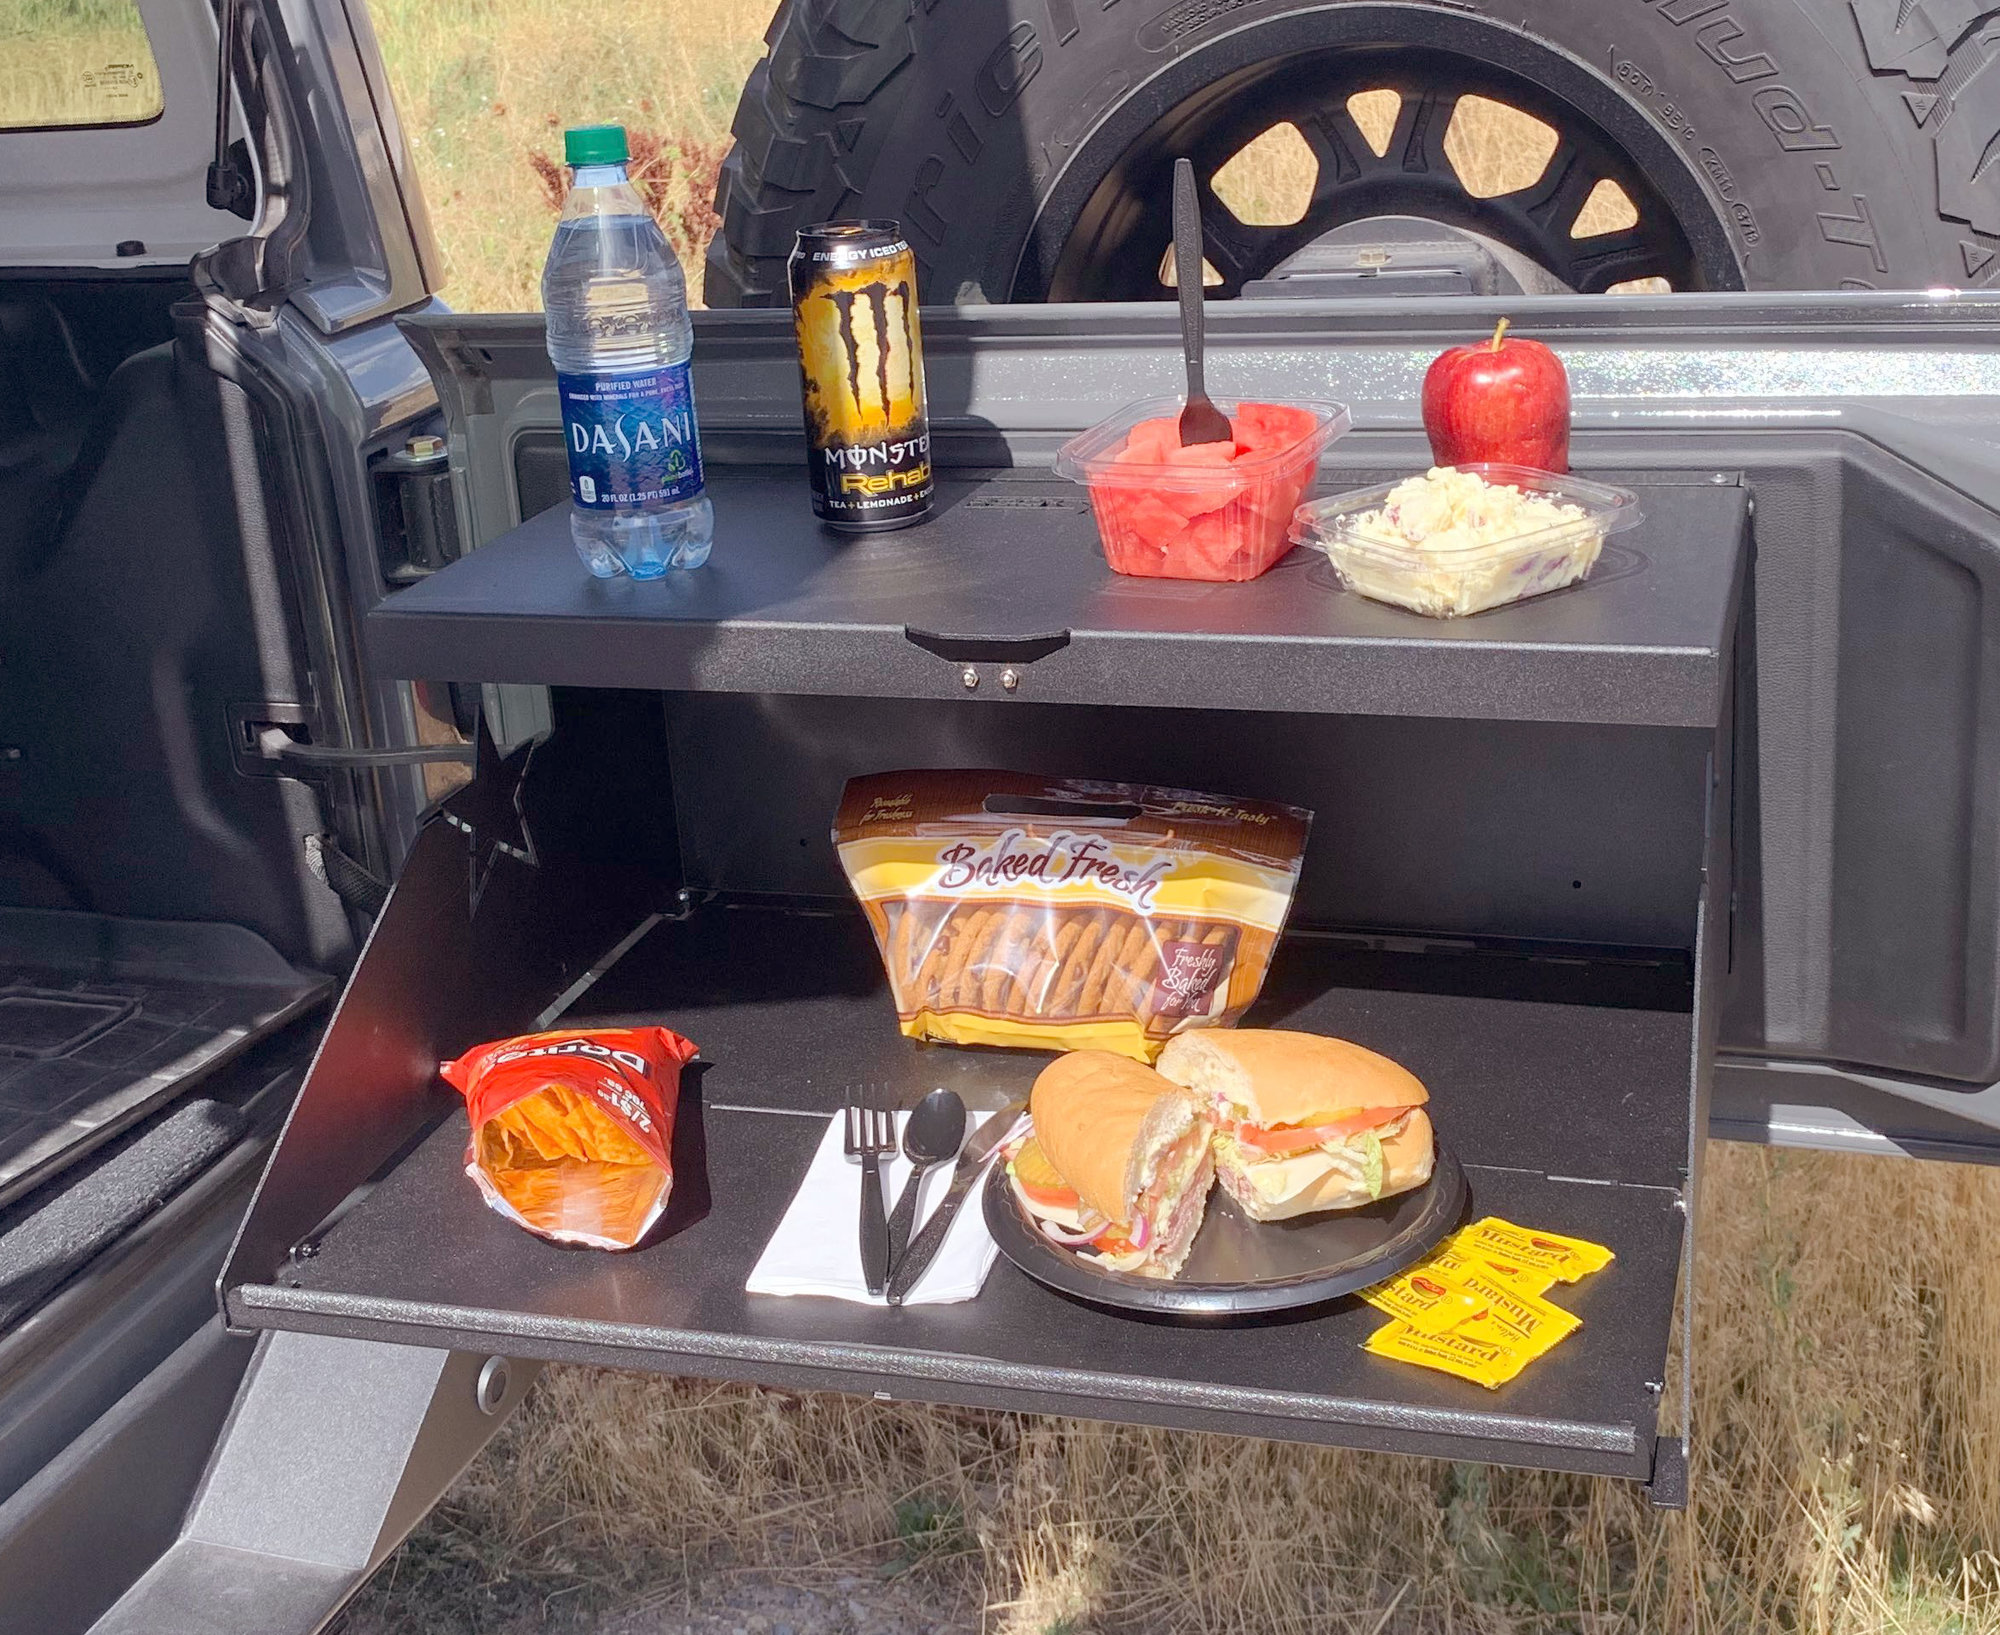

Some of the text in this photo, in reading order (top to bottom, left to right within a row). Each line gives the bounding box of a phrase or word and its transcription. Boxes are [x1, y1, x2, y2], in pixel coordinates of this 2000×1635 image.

[1618, 64, 1653, 94] DOT
[869, 243, 897, 259] ICED
[595, 377, 657, 391] PURIFIED WATER
[571, 411, 691, 462] DASANI
[825, 432, 930, 470] MONSTE
[840, 461, 931, 498] Rehab
[601, 493, 610, 503] 20
[610, 493, 619, 503] FL
[619, 493, 628, 502] OZ
[829, 500, 846, 509] TEA
[856, 494, 913, 509] LEMONADE
[938, 832, 1173, 910] Baked Fresh
[1172, 947, 1216, 977] Freshly
[1161, 966, 1218, 996] Baked
[1160, 991, 1183, 1011] for
[1462, 1277, 1545, 1334] Mustard
